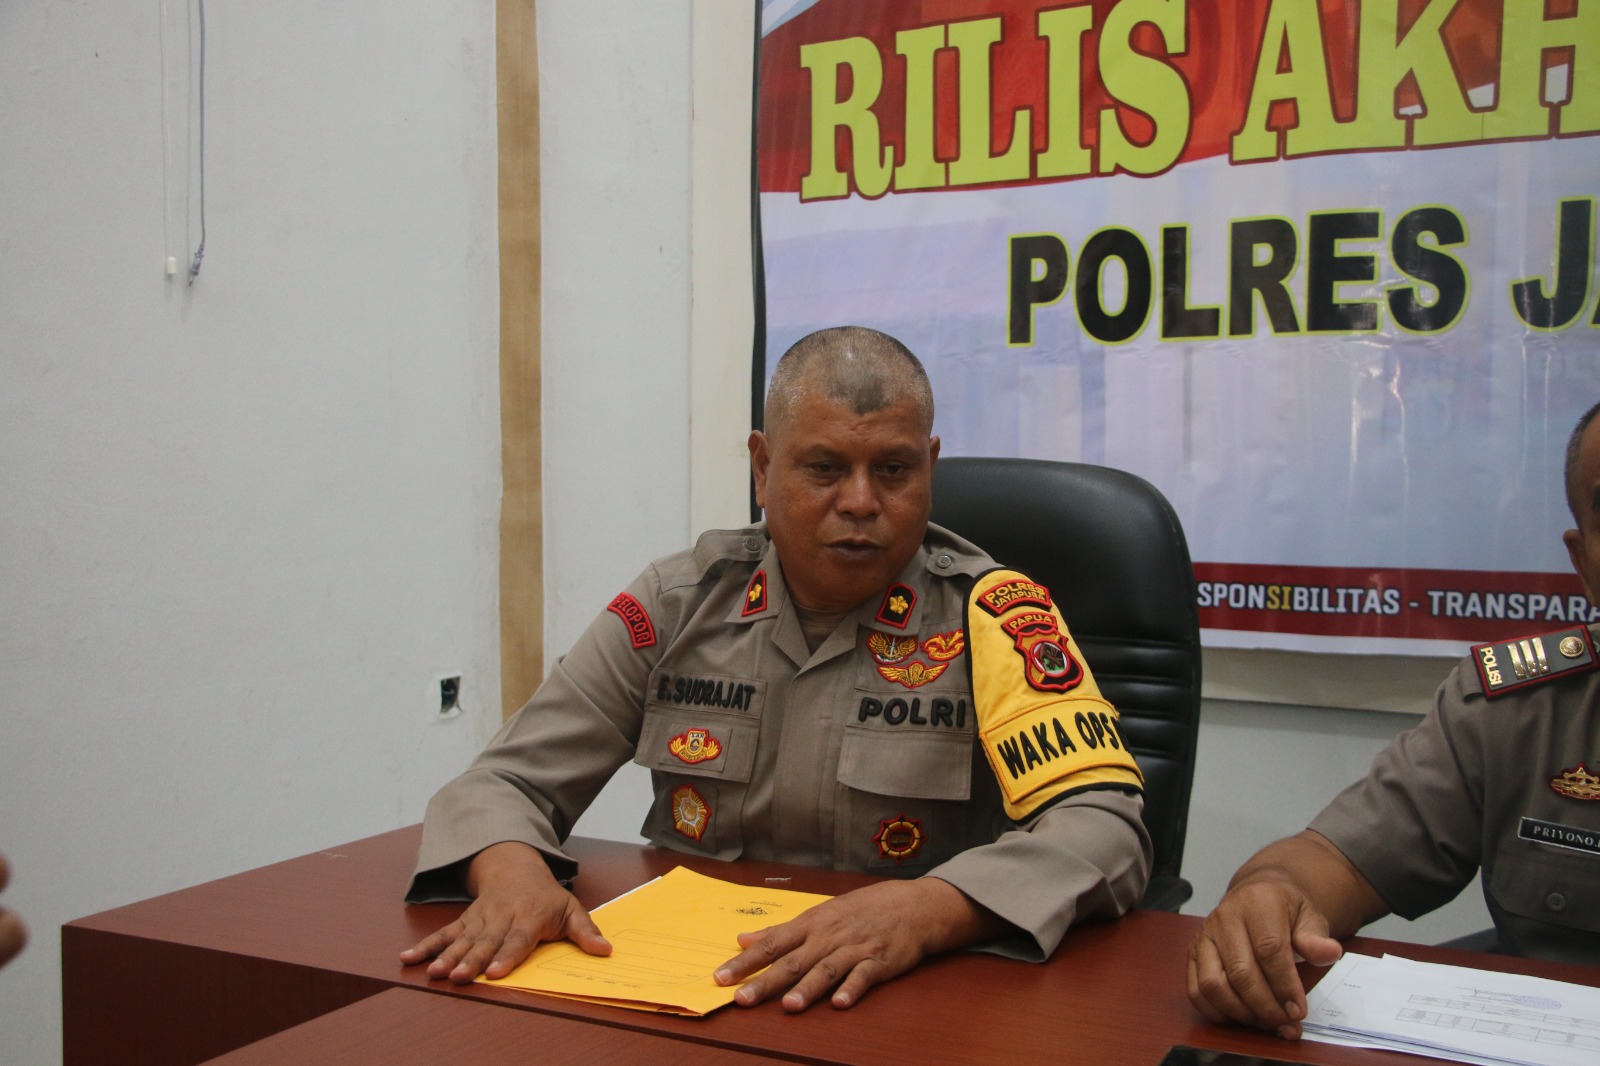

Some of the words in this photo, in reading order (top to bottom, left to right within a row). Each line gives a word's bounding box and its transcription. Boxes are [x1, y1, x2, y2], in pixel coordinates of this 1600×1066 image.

[799, 0, 1194, 202] RILIS
[1006, 203, 1468, 348] POLRES
[1509, 195, 1600, 332] J
[984, 582, 1046, 604] POLRES
[994, 590, 1046, 608] JAYAPURA
[1196, 581, 1400, 616] SPONSIBILITAS
[611, 595, 650, 643] PELOPOR
[1009, 614, 1052, 629] PAPUA
[1480, 646, 1503, 686] POLISI
[858, 696, 966, 728] POLRI
[997, 716, 1078, 780] WAKA
